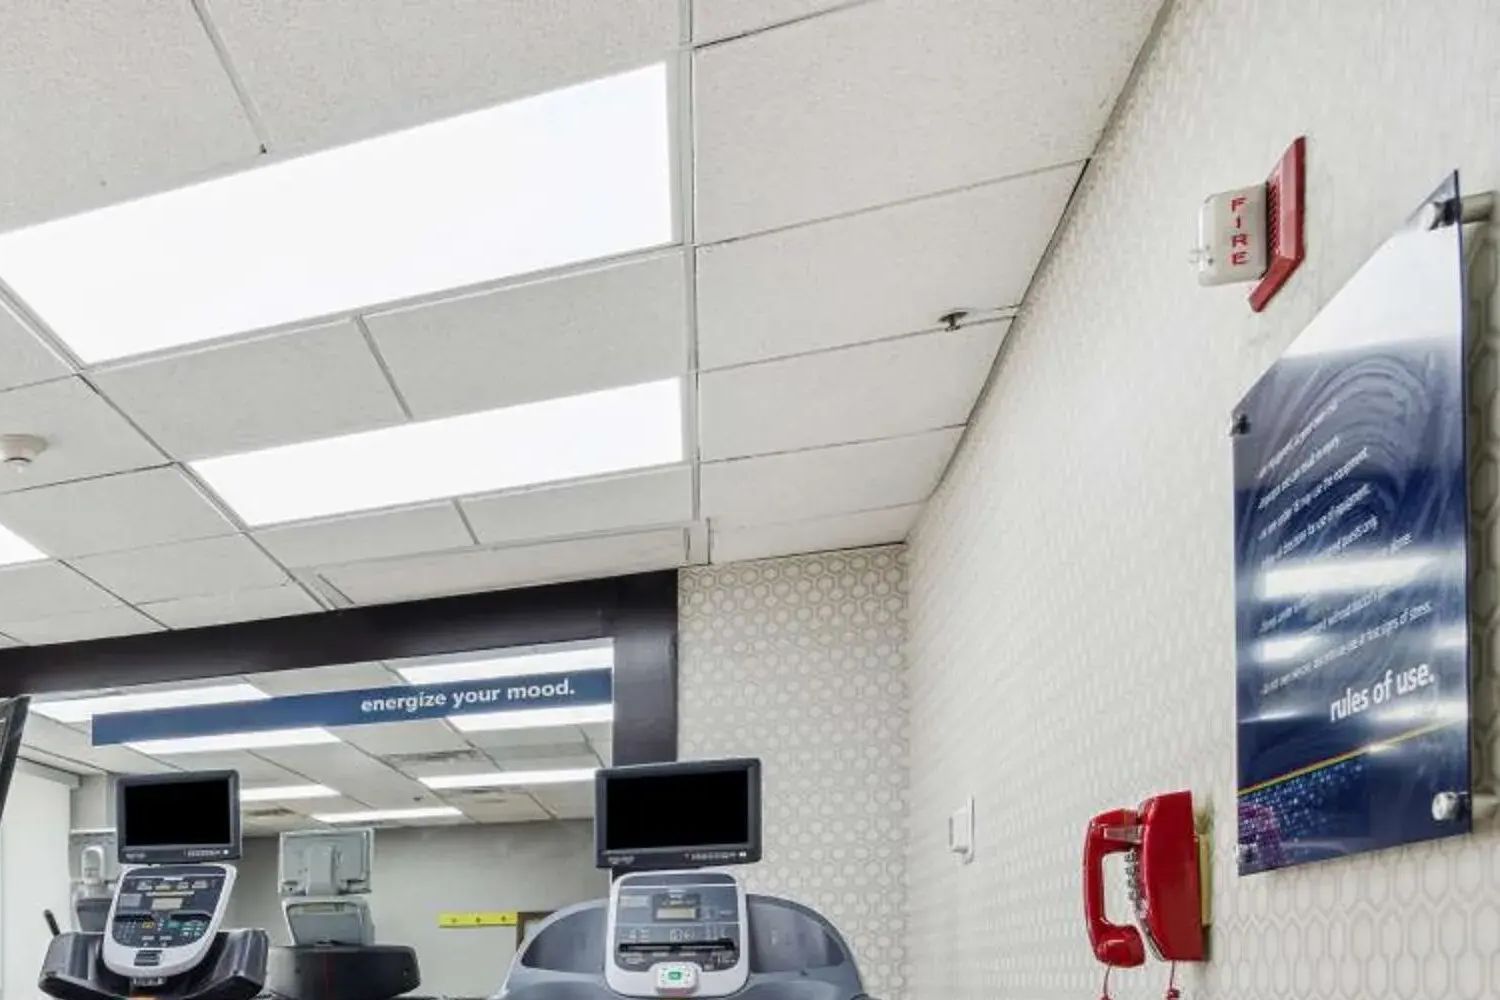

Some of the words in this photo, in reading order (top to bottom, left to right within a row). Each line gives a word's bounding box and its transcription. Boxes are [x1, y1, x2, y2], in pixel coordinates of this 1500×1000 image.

[1230, 197, 1248, 266] FIRE
[361, 691, 448, 713] energize
[452, 687, 501, 708] your
[507, 678, 576, 699] mood.
[1330, 688, 1369, 722] rules
[1373, 670, 1394, 705] of
[1396, 663, 1435, 695] use.
